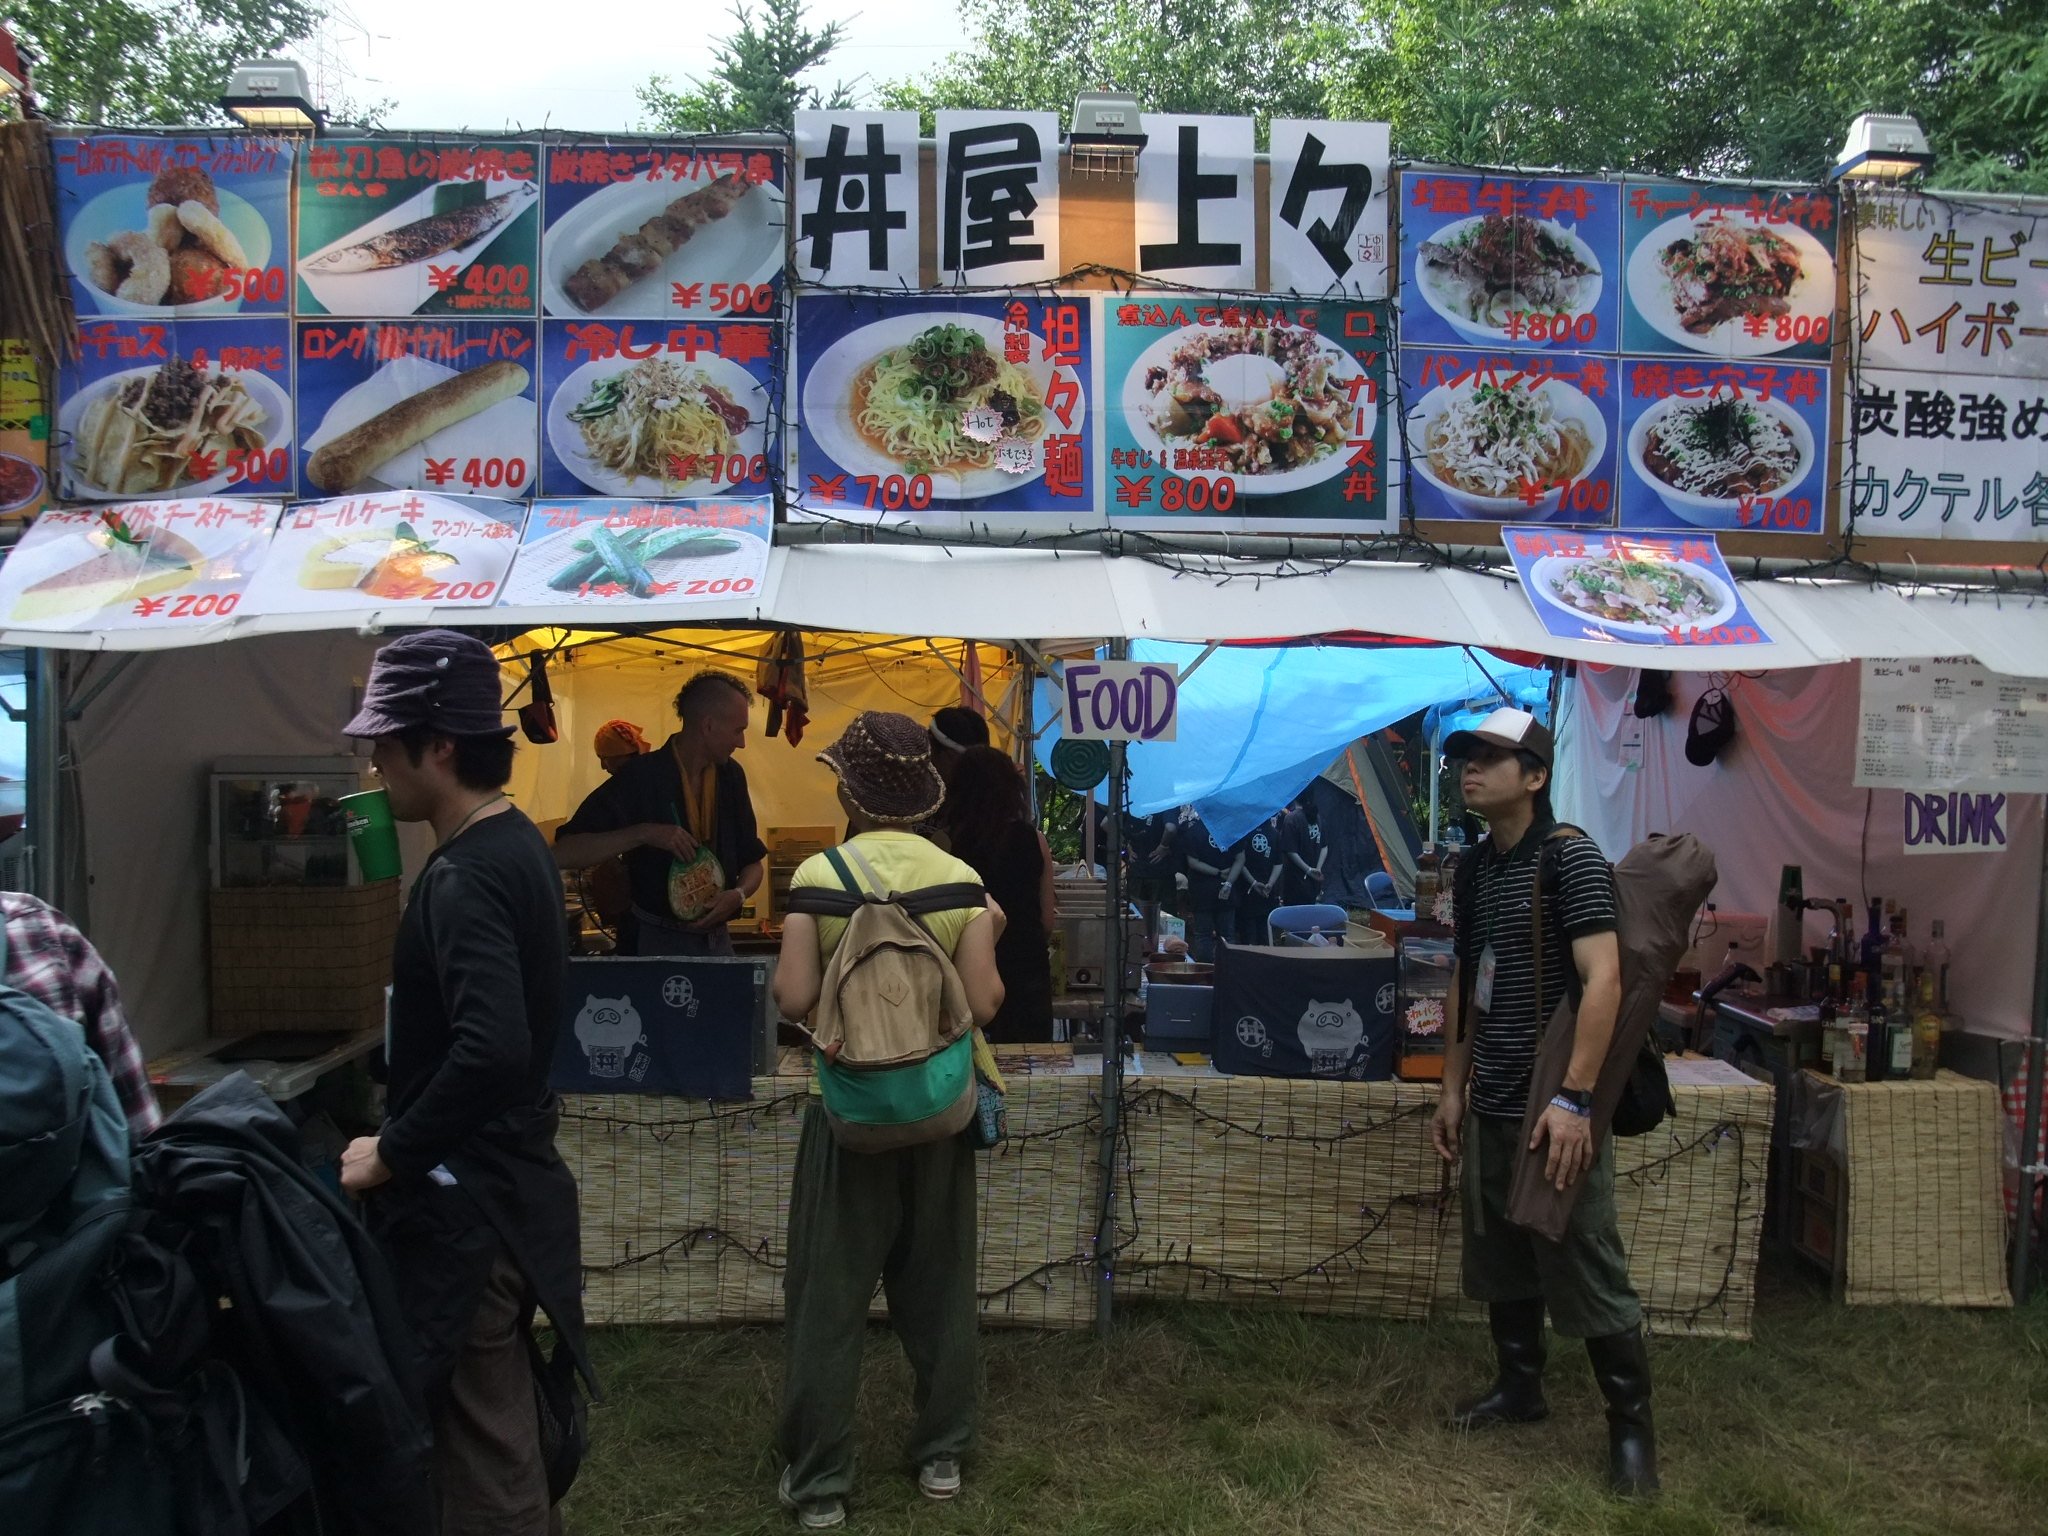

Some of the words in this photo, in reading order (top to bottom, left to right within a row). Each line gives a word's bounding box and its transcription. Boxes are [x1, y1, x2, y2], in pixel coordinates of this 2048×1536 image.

[185, 267, 285, 303] ¥500
[427, 264, 529, 295] ¥400
[672, 282, 772, 314] ¥500
[1117, 304, 1319, 328] 煮込んで煮込んで
[1504, 310, 1597, 343] ¥800
[1743, 311, 1830, 343] ¥800
[565, 323, 772, 364] 冷し中華
[1004, 300, 1030, 365] 冷製
[1631, 364, 1821, 404] 焼き穴子丼
[966, 415, 994, 429] Hot
[188, 448, 288, 483] ¥500
[424, 457, 526, 488] ¥400
[667, 453, 768, 484] ¥700
[1111, 448, 1152, 469] 牛すじ
[808, 474, 933, 510] ¥700
[1115, 475, 1236, 512] ¥800
[1519, 477, 1610, 512] ¥700
[292, 498, 425, 529] ロールケーキ
[1736, 495, 1812, 528] ¥700
[384, 581, 496, 601] ¥200
[645, 578, 754, 597] ¥200
[132, 594, 241, 618] ¥200
[1873, 668, 1904, 677] 生ビール
[1065, 665, 1176, 740] FOOD
[1904, 792, 2006, 846] DRINK
